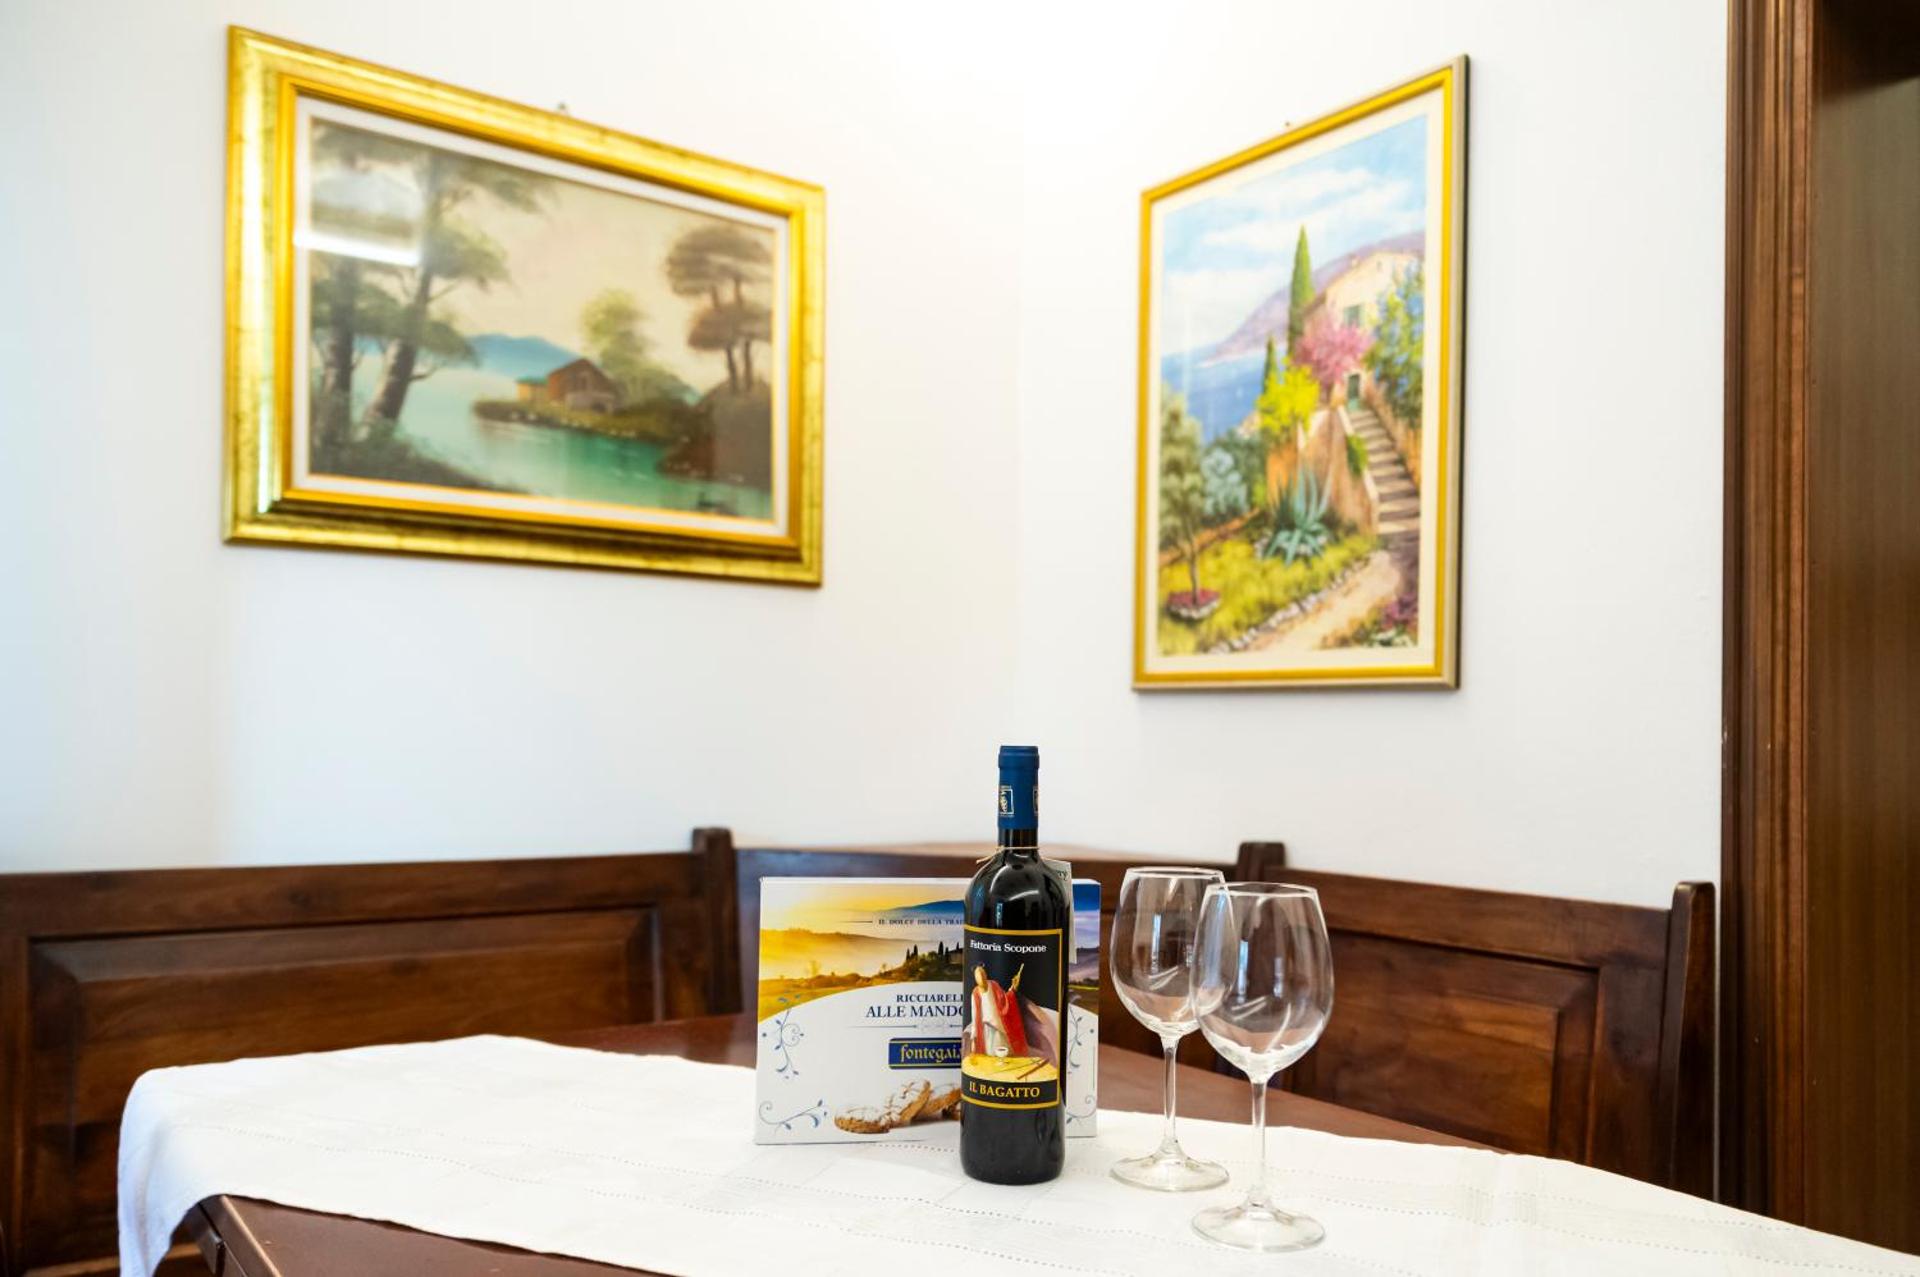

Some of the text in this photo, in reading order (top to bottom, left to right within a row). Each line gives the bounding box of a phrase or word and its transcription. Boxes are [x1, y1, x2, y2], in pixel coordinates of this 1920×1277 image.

[970, 939, 1047, 953] Fattoria Scopone
[866, 1005, 907, 1018] ALLE
[901, 1043, 961, 1063] fontegai
[969, 1080, 1040, 1098] IL BAGATTO
